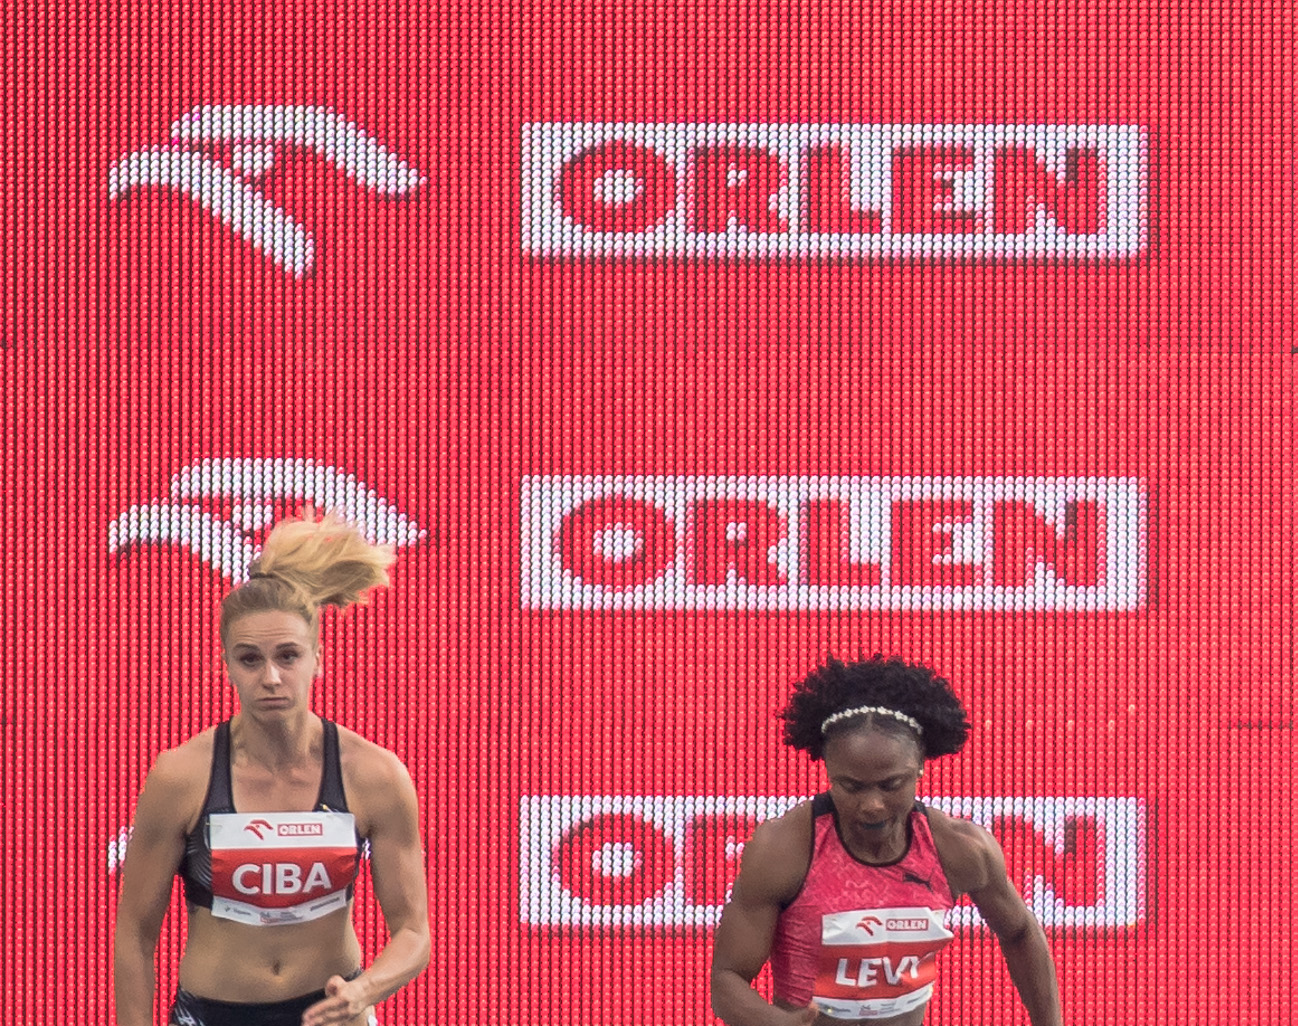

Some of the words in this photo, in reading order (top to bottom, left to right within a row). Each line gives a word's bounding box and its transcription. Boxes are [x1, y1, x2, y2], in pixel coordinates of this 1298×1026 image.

[555, 139, 1102, 234] ORLEN
[555, 494, 1102, 590] ORLEN
[279, 824, 321, 835] ORLEN
[232, 862, 332, 895] CIBA
[887, 919, 927, 930] ORLEN
